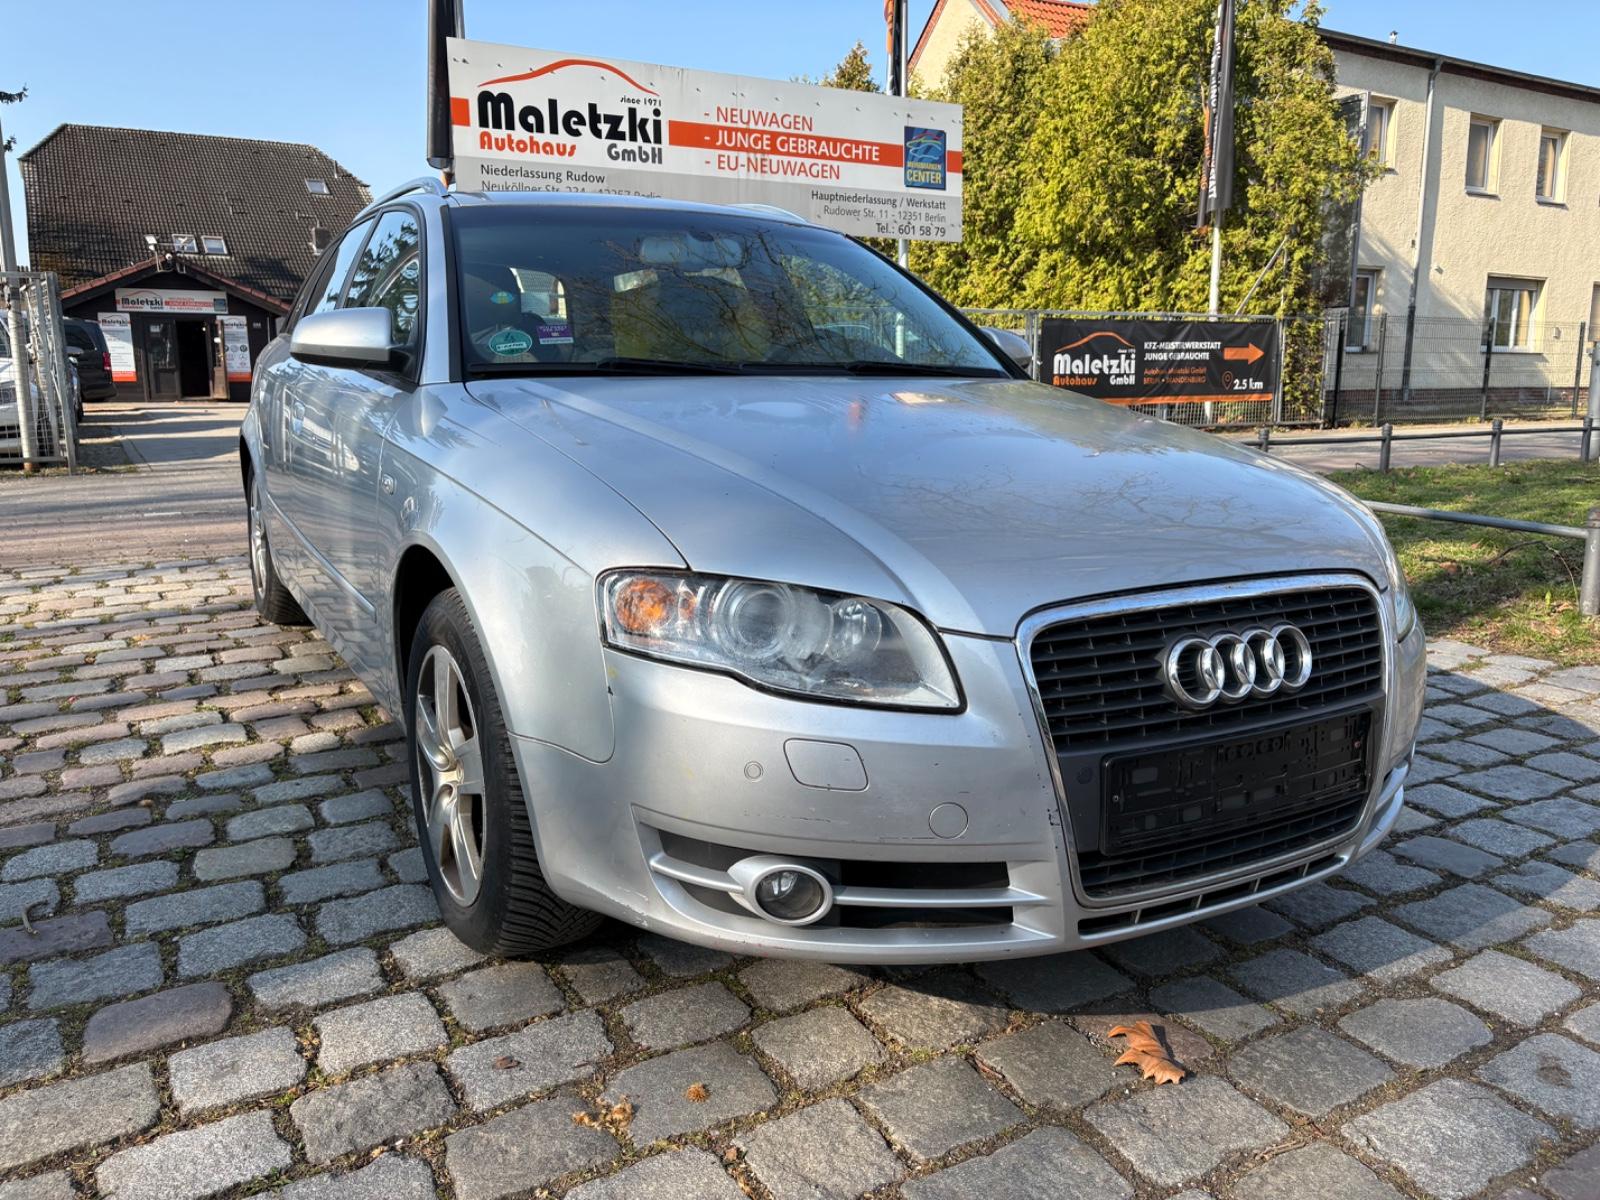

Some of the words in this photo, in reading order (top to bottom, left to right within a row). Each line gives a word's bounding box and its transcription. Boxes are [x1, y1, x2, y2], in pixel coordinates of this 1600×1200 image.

[643, 98, 662, 107] 1971
[477, 90, 662, 145] Maletzki
[716, 106, 813, 131] NEUWAGEN
[480, 131, 576, 157] Autohaus
[607, 143, 662, 164] GmbH
[716, 129, 772, 150] JUNGE
[776, 136, 880, 161] GEBRAUCHTE
[481, 164, 562, 183] Niederlassung
[566, 170, 606, 184] Rudow
[717, 154, 841, 180] EU-NEUWAGEN
[906, 169, 942, 185] CENTER
[811, 190, 897, 208] Hauptniederlassung
[906, 198, 946, 210] Werkstatt
[824, 205, 860, 217] Rudower
[880, 210, 888, 219] 11
[899, 211, 921, 221] 12351
[924, 213, 946, 223] Berlin
[898, 224, 915, 235] 601
[920, 226, 931, 236] 58
[934, 227, 946, 237] 79
[1053, 353, 1136, 375] Maletzki
[1144, 352, 1168, 361] JUNGE
[1053, 375, 1098, 386] Autohaus
[1110, 374, 1136, 386] GmbH
[1233, 378, 1248, 390] 2.5
[1249, 377, 1264, 390] km
